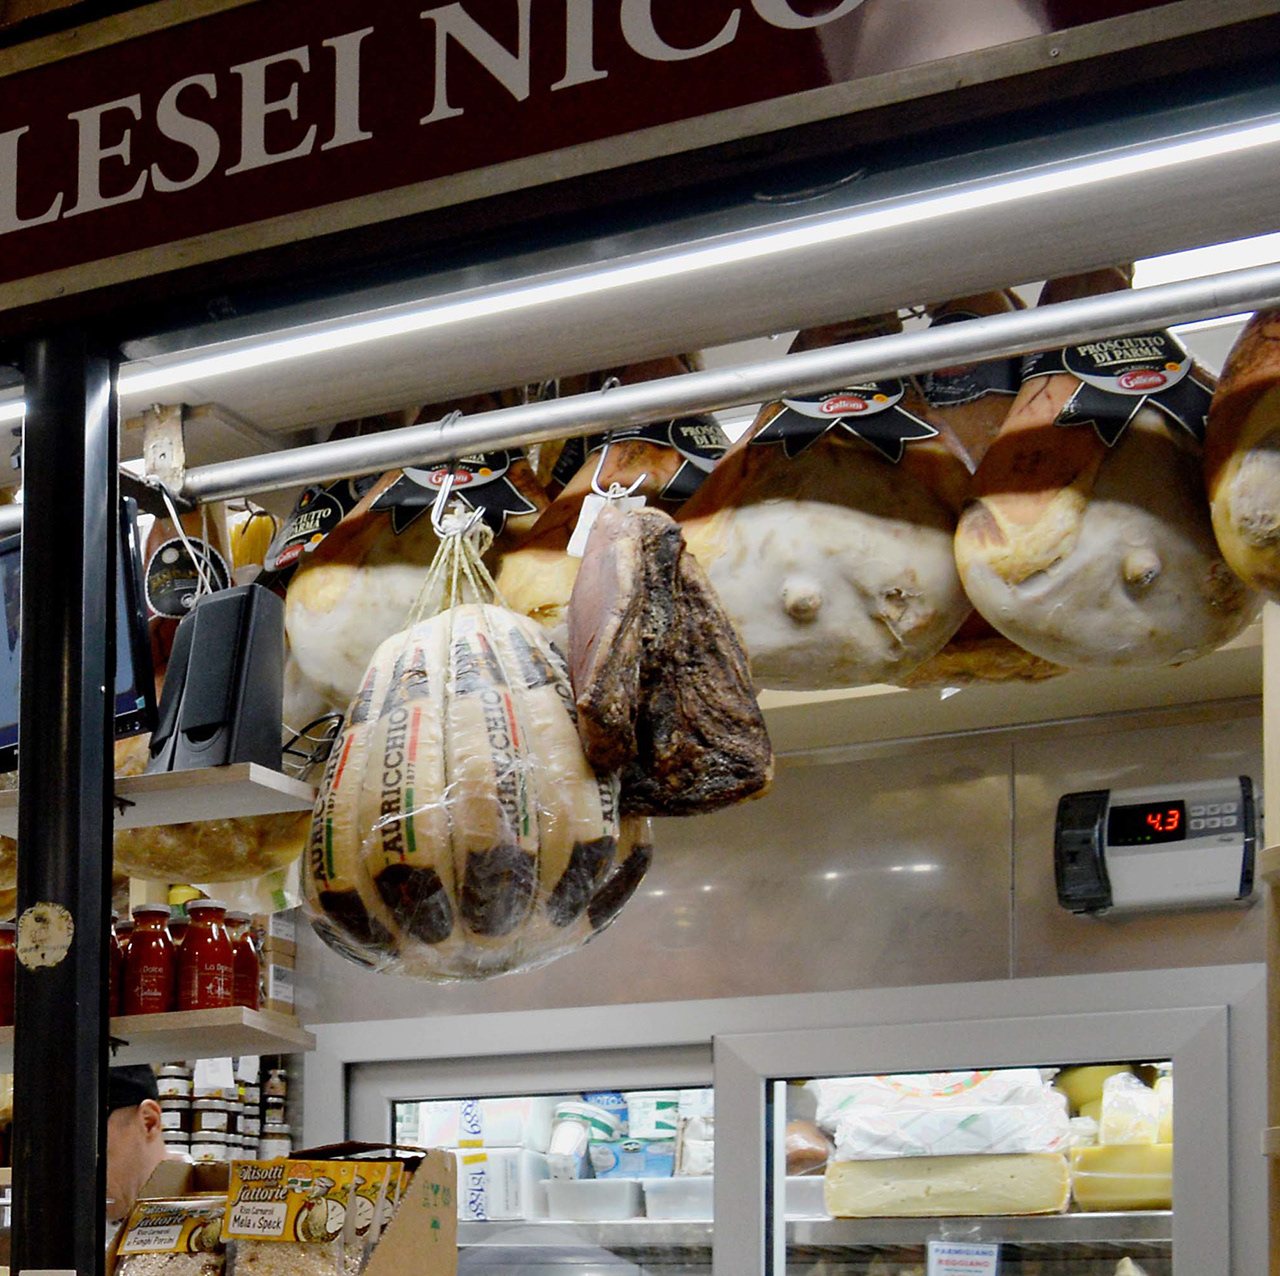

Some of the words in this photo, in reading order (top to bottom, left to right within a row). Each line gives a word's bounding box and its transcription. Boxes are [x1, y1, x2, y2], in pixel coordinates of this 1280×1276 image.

[1078, 336, 1165, 356] PROSCIUTTO
[1094, 353, 1110, 364] DI
[1116, 346, 1163, 361] PARMA
[381, 706, 409, 855] AURICCHIO
[1145, 808, 1180, 831] 4.3
[240, 1165, 284, 1182] Risotti
[232, 1184, 288, 1206] fattorie
[231, 1215, 251, 1229] Mela
[257, 1216, 282, 1231] Speck
[132, 1237, 152, 1247] Funghi
